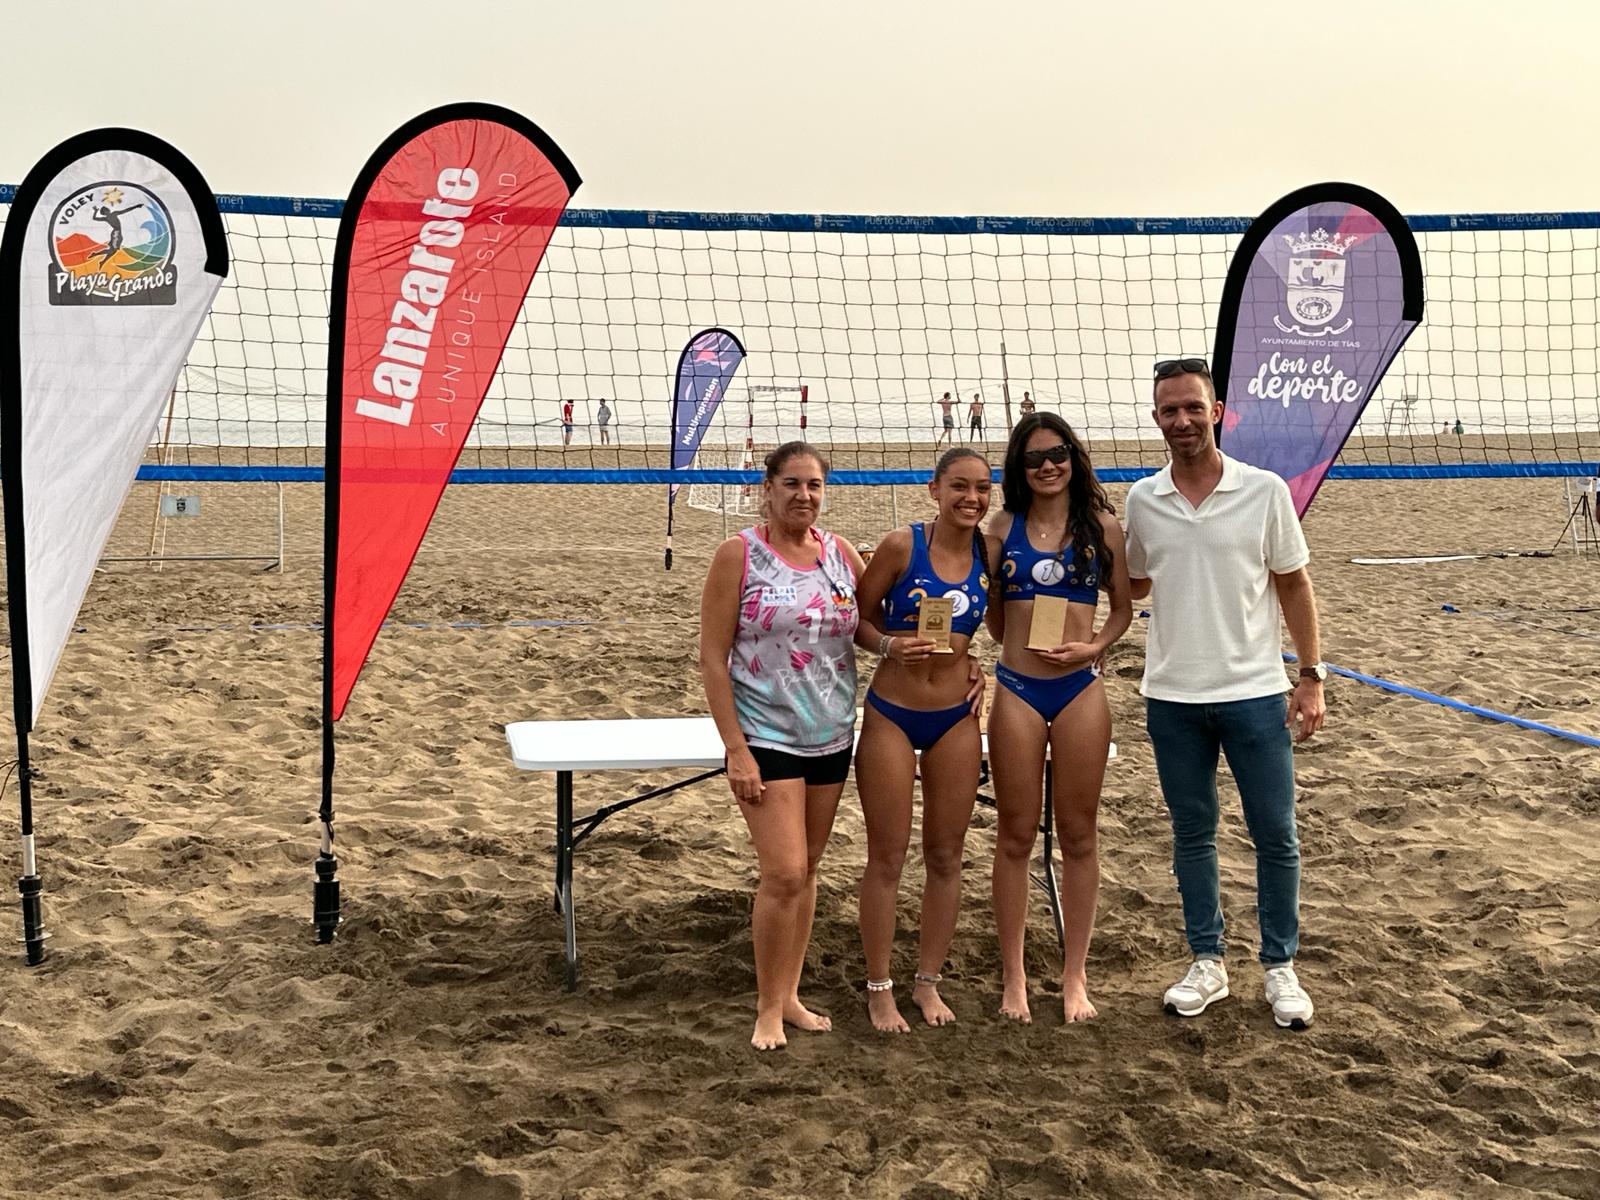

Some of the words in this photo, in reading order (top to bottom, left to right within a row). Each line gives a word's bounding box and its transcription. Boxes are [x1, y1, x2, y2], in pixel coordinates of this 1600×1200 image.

[59, 193, 95, 226] VOLEY
[215, 195, 244, 205] rmen
[473, 172, 517, 273] ISLAND
[55, 270, 108, 296] Playa
[108, 266, 174, 302] Grande
[354, 167, 480, 427] Lanzarote
[437, 288, 483, 403] UNIQUE
[1261, 337, 1326, 347] AYUNTAMIENTO
[1269, 351, 1308, 375] Con
[1312, 354, 1333, 375] el
[1248, 363, 1363, 408] deporte
[430, 421, 449, 437] A
[805, 607, 822, 644] 1
